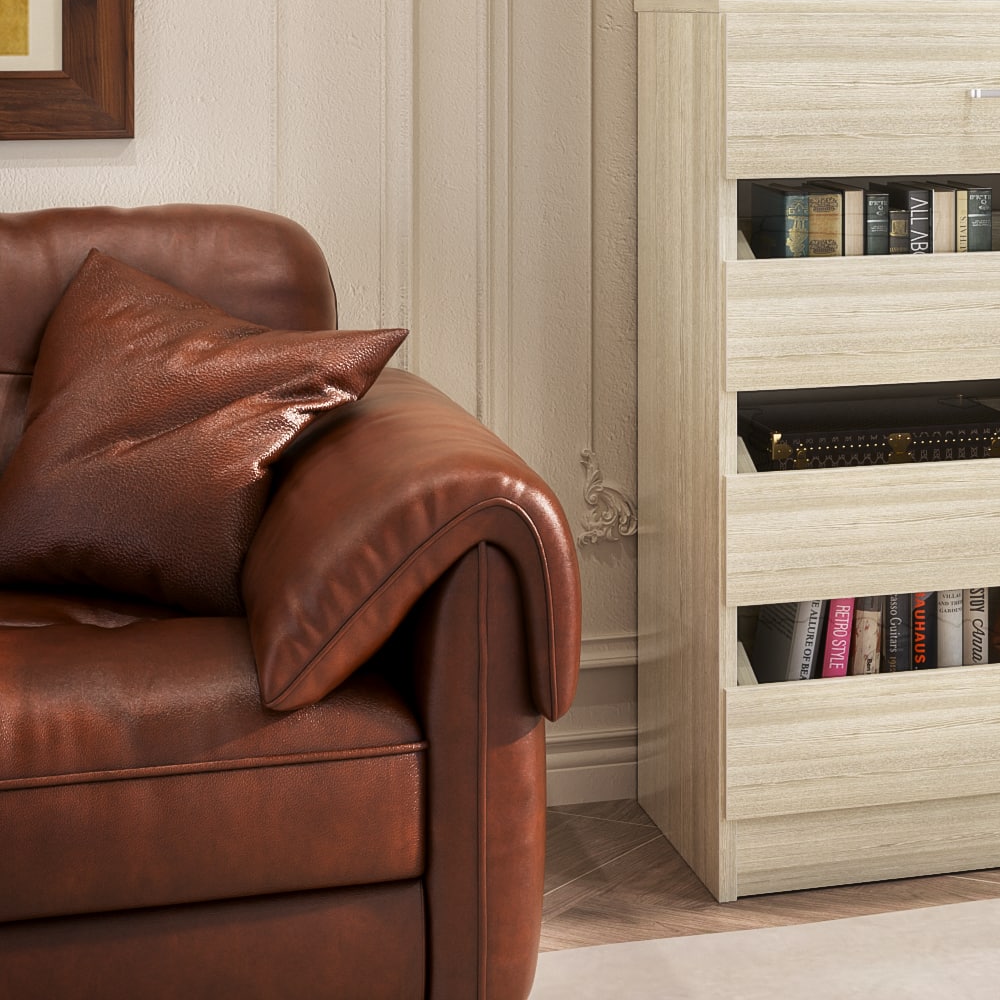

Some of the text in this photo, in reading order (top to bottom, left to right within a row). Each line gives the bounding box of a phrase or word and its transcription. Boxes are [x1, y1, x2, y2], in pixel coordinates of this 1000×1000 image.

[910, 196, 929, 225] ALL
[889, 594, 898, 616] asso
[804, 607, 819, 647] ALLURE
[828, 604, 851, 669] RETRO STYLE
[889, 617, 903, 653] Guitars
[914, 592, 926, 664] BAUHAUS
[971, 618, 986, 664] Anna
[802, 648, 812, 663] OF
